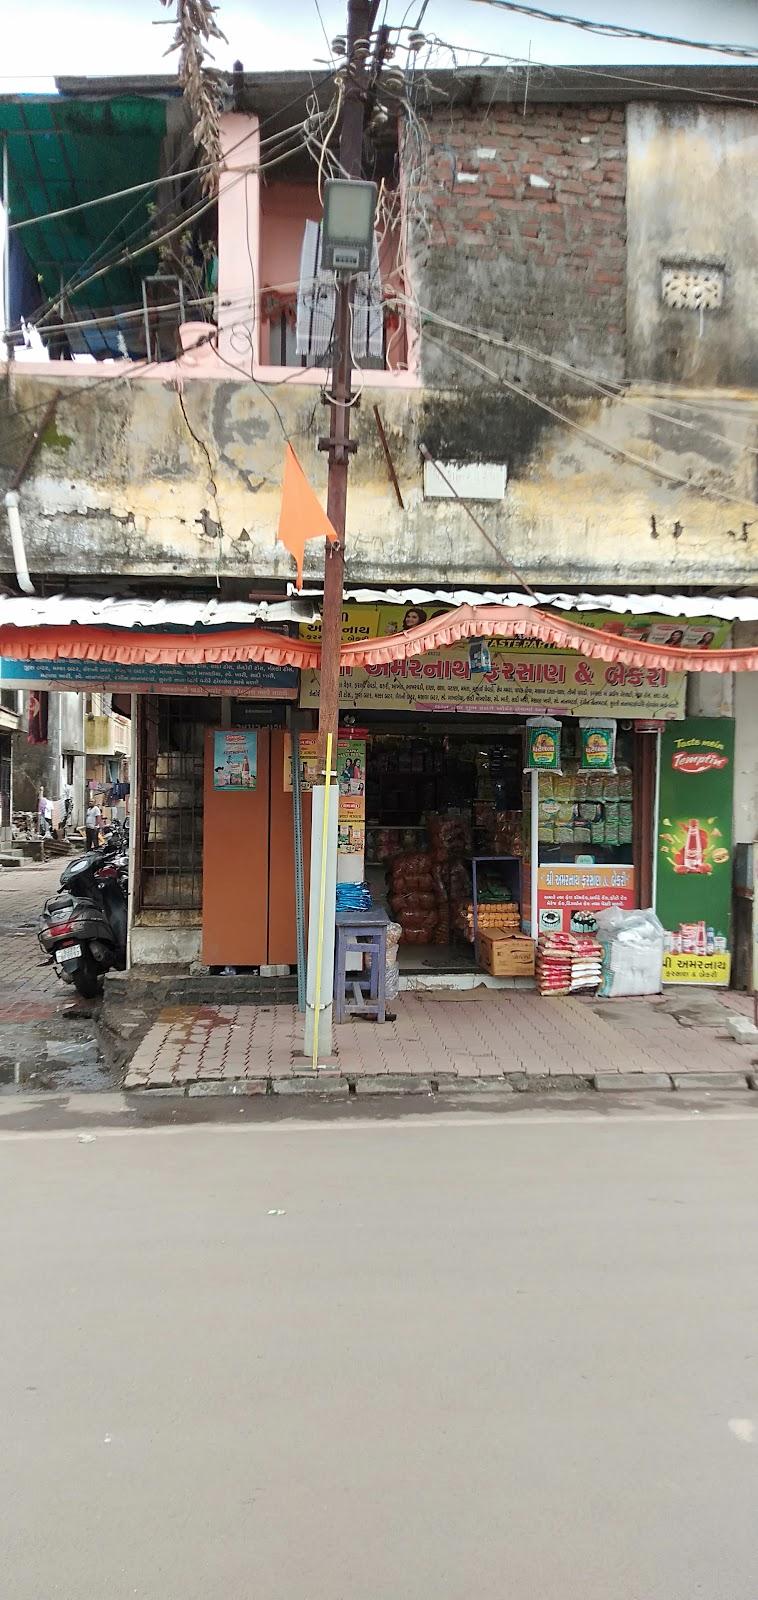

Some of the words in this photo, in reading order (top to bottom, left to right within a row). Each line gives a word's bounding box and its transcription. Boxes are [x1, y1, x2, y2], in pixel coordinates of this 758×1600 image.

[574, 660, 595, 685] &
[673, 738, 701, 749] Taste
[677, 959, 727, 970] અમરનાથ
